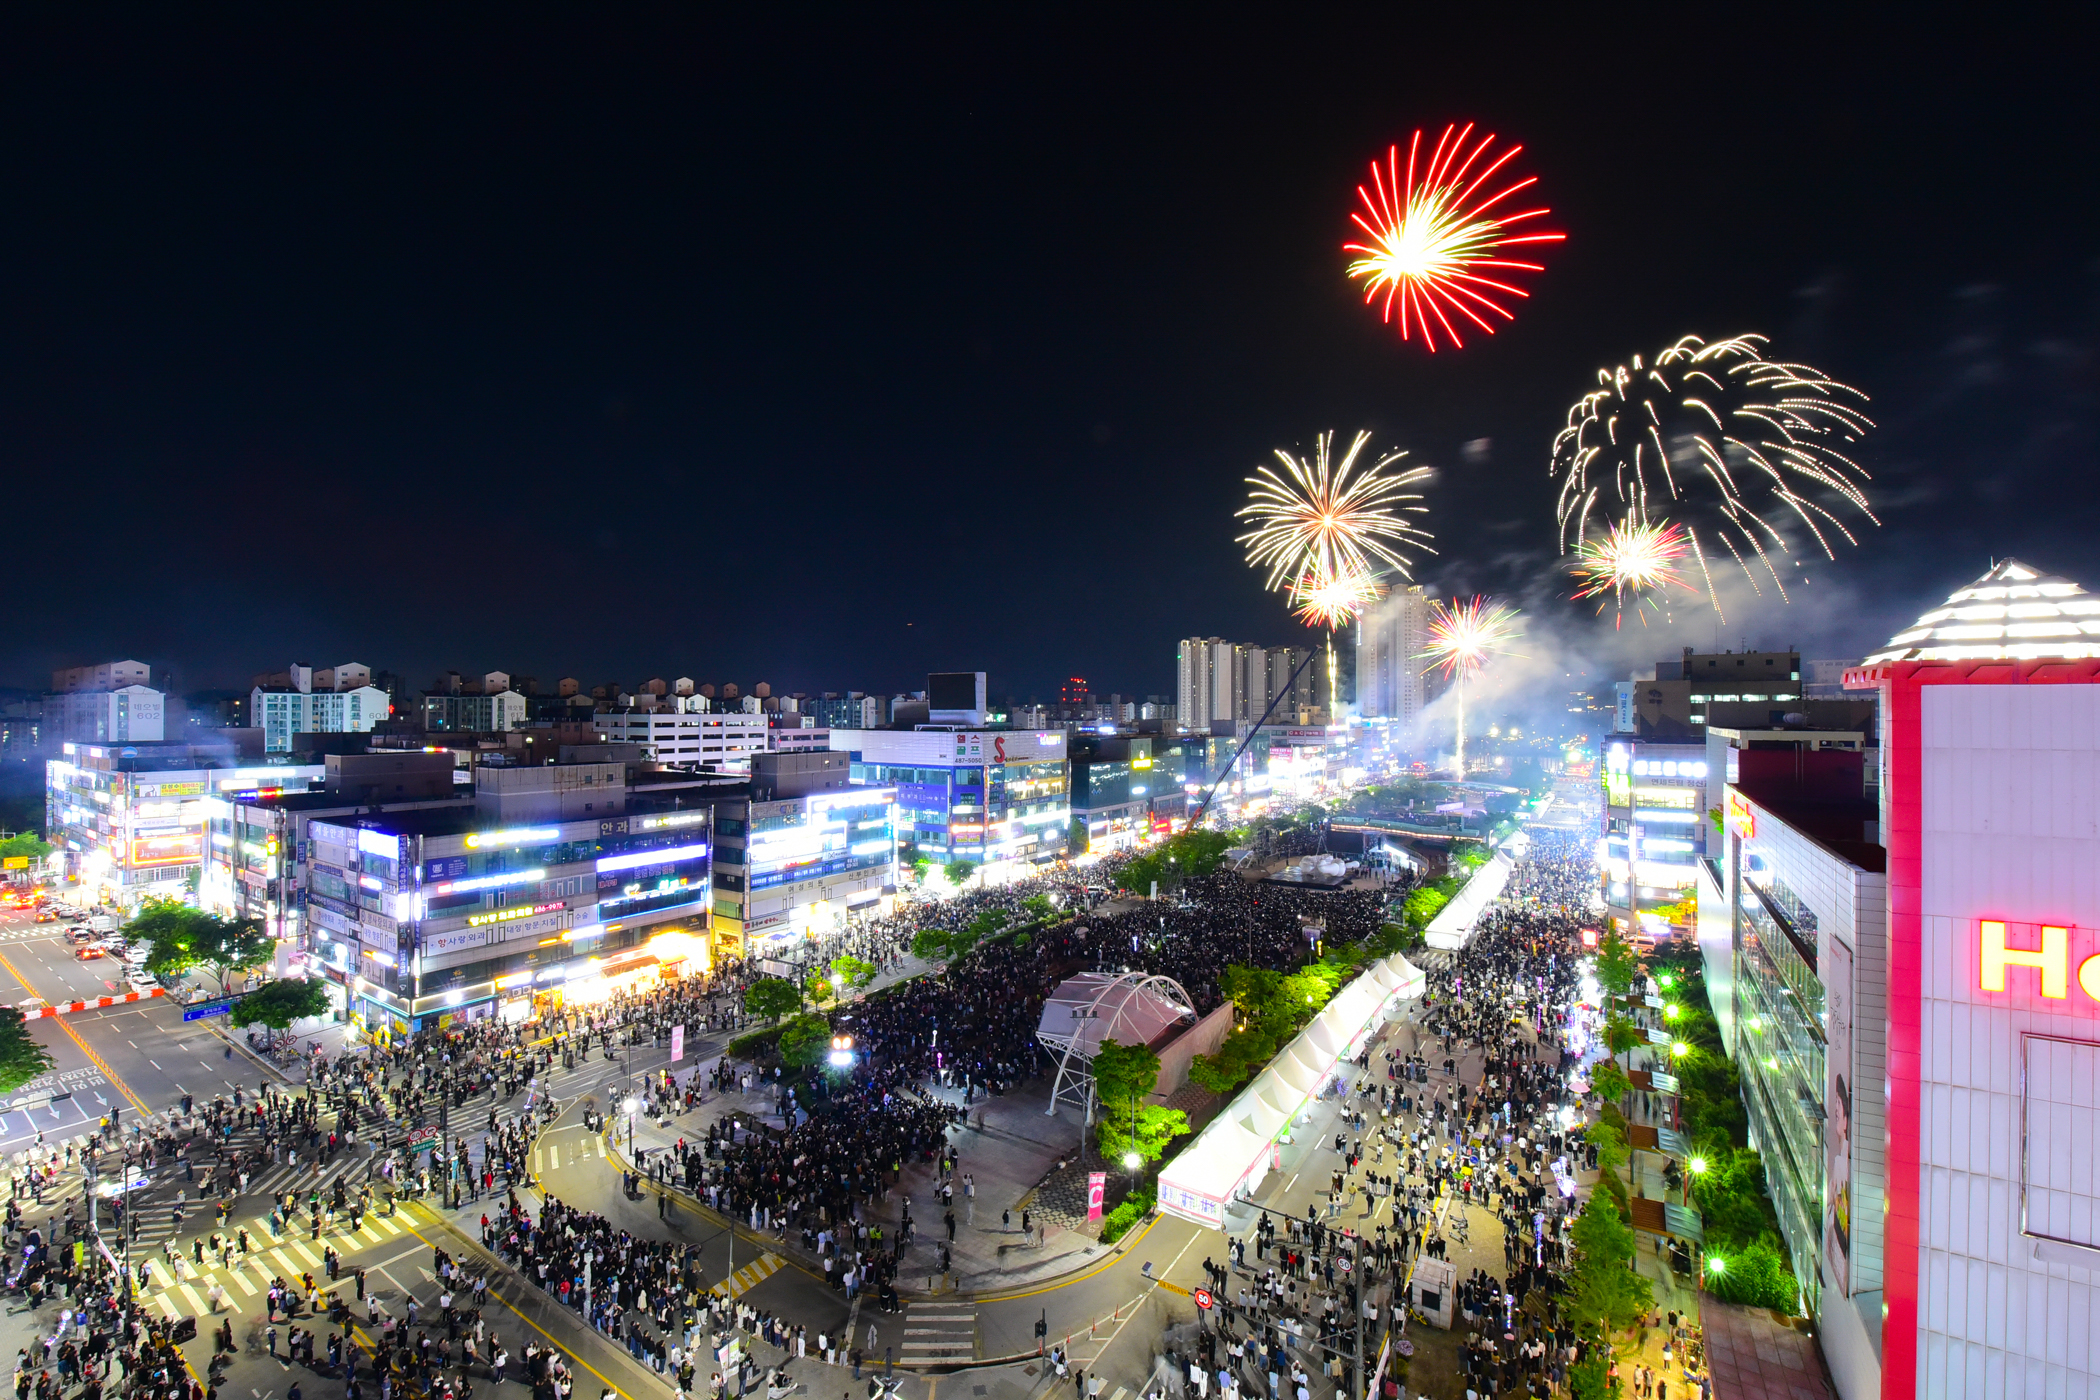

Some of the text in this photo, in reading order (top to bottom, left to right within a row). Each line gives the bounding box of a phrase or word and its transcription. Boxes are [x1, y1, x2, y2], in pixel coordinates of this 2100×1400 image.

[134, 703, 161, 711] 네오빌
[137, 712, 161, 720] 602
[957, 734, 980, 743] 헬스
[1651, 778, 1684, 787] 연세드림
[315, 823, 345, 841] 서울안과
[601, 820, 629, 836] 안과
[848, 868, 878, 881] 산부인과
[788, 879, 824, 893] 여성의원
[534, 902, 564, 914] 486-9975
[575, 911, 589, 921] 수술
[507, 917, 557, 934] 대장 항문 치질
[438, 932, 486, 949] 항사랑외과
[1339, 1260, 1350, 1269] 50
[1198, 1294, 1209, 1305] 50
